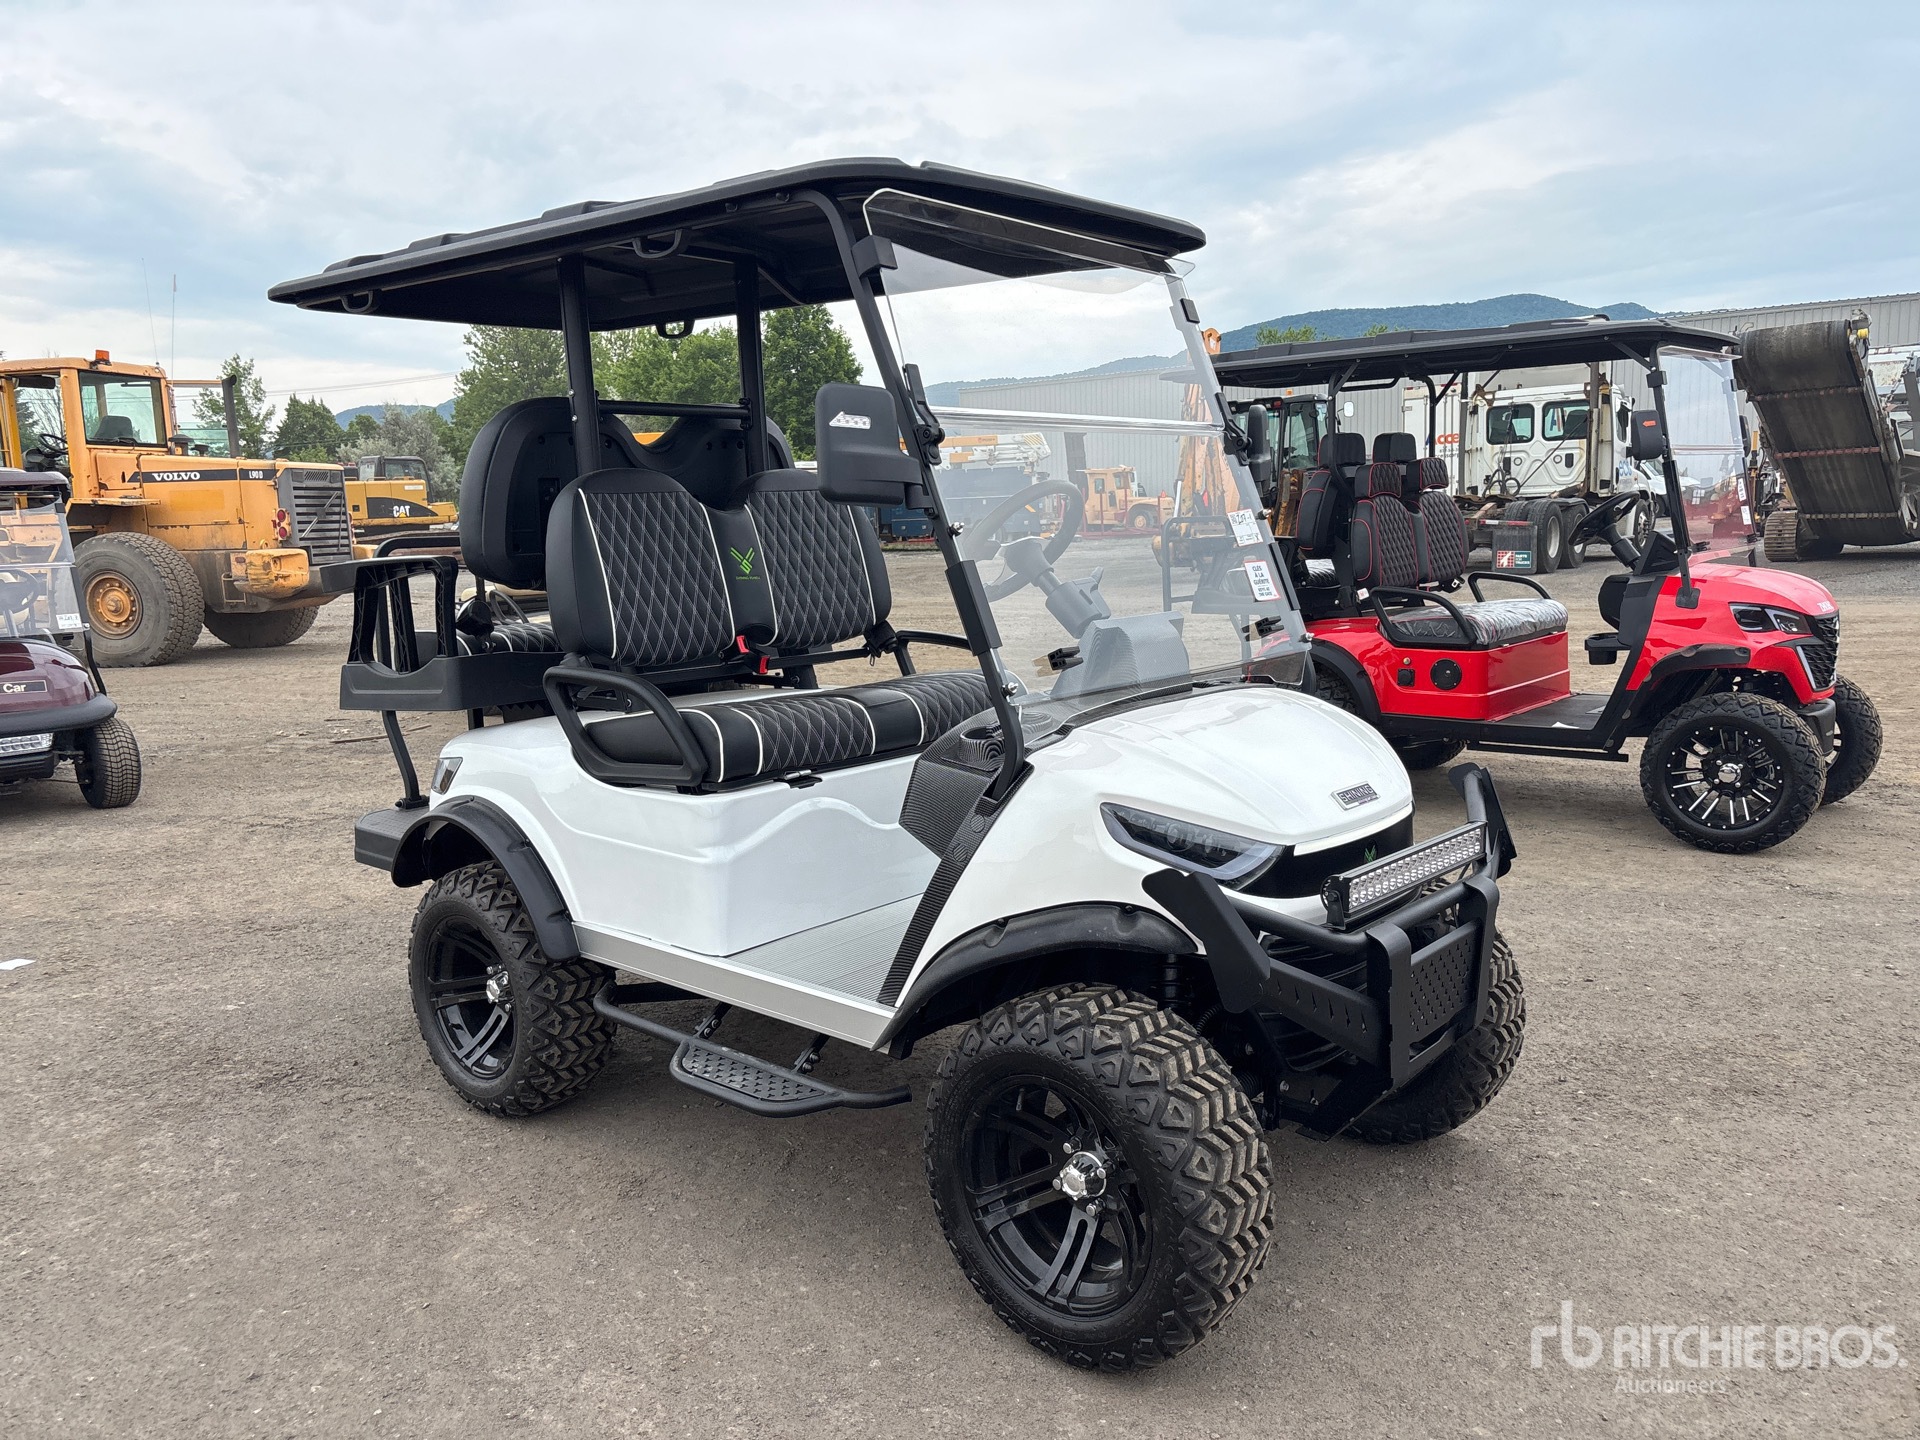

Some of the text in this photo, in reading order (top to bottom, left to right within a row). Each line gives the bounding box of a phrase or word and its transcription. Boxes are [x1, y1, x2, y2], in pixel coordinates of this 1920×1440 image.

[152, 472, 200, 481] VOLVO
[393, 505, 410, 518] CAT
[2, 683, 27, 693] Car
[1339, 785, 1374, 802] SHINING
